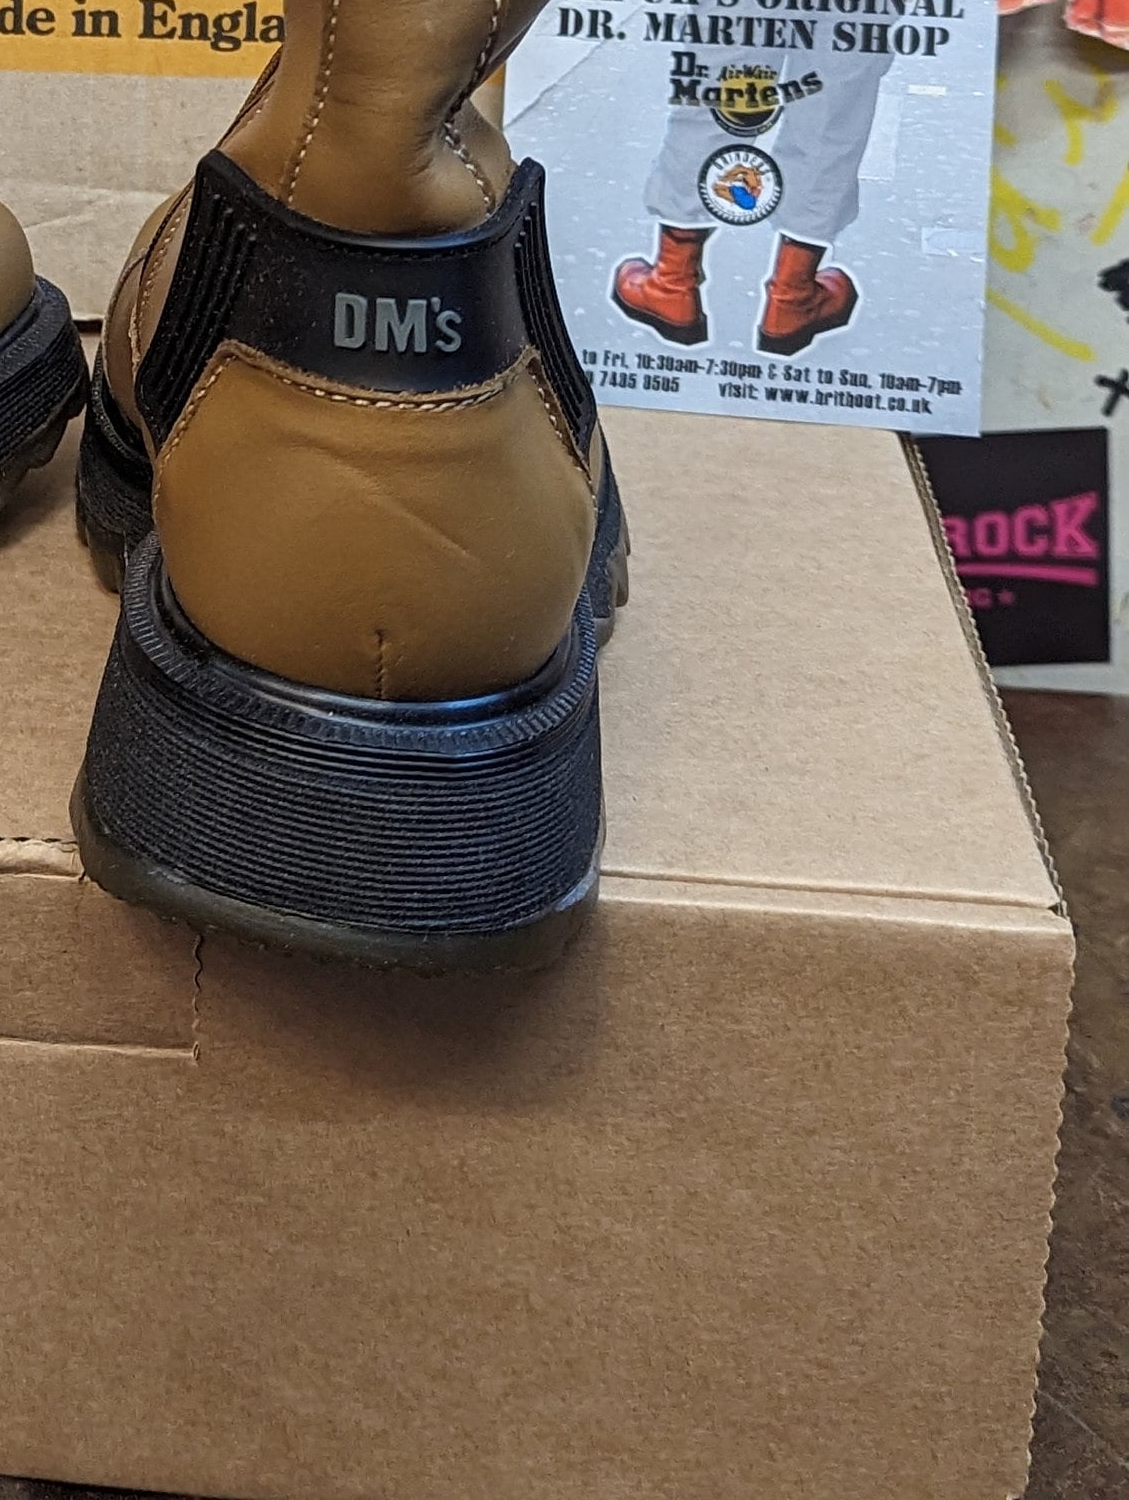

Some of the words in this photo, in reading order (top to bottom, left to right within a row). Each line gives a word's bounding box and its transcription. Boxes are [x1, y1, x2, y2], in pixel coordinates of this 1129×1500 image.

[556, 7, 626, 41] DR.
[643, 11, 819, 51] MARTEN
[831, 20, 951, 57] SHOP
[669, 50, 709, 79] Dr.
[669, 69, 824, 109] Martens
[333, 291, 463, 353] DM's
[783, 364, 810, 384] Sat
[817, 368, 833, 385] to
